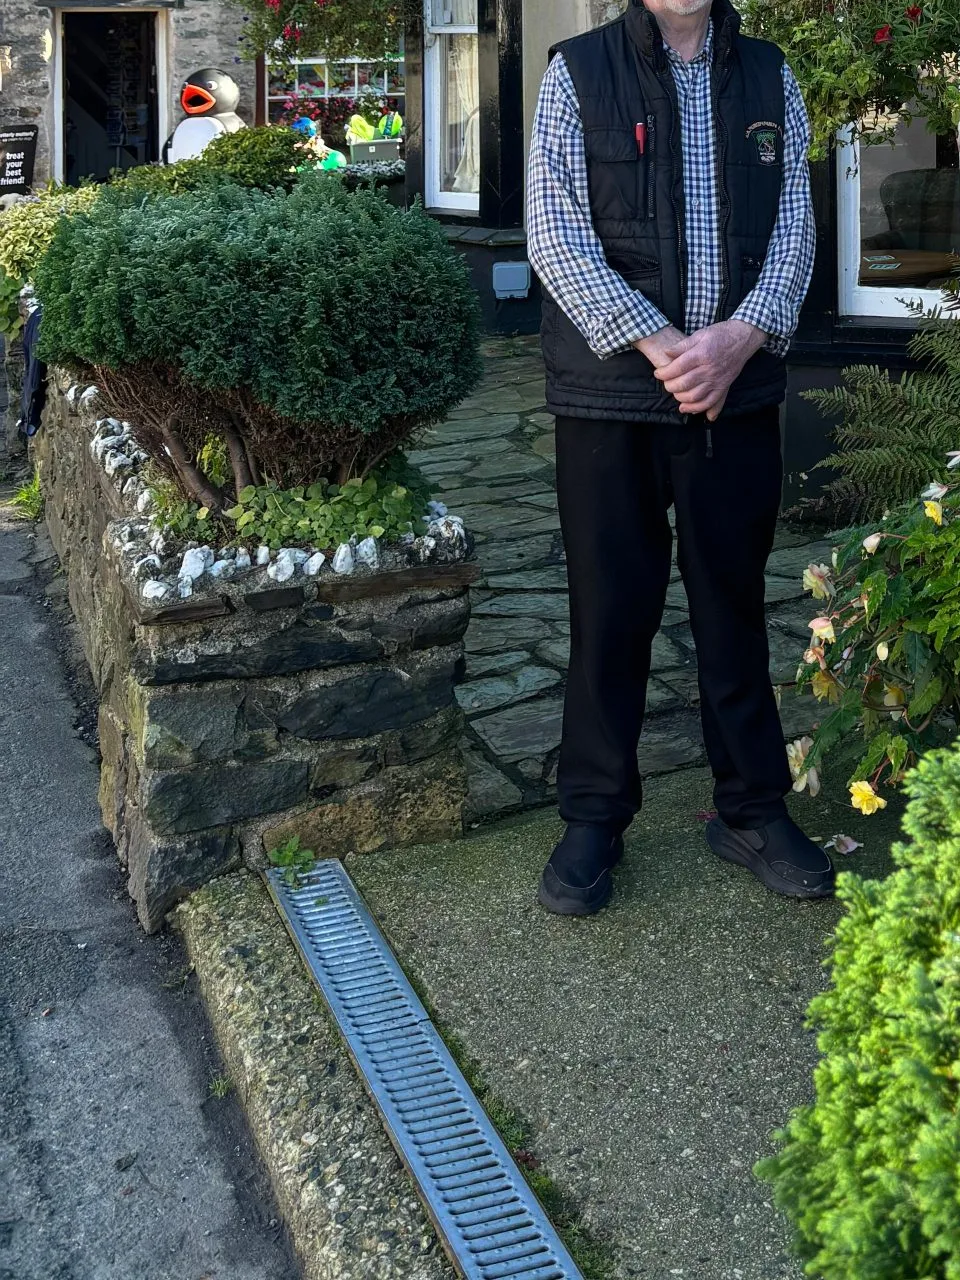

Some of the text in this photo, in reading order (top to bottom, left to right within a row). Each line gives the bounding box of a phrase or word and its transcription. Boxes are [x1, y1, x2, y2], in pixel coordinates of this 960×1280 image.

[6, 152, 24, 160] treat
[6, 161, 23, 170] your
[1, 176, 25, 185] friend!
